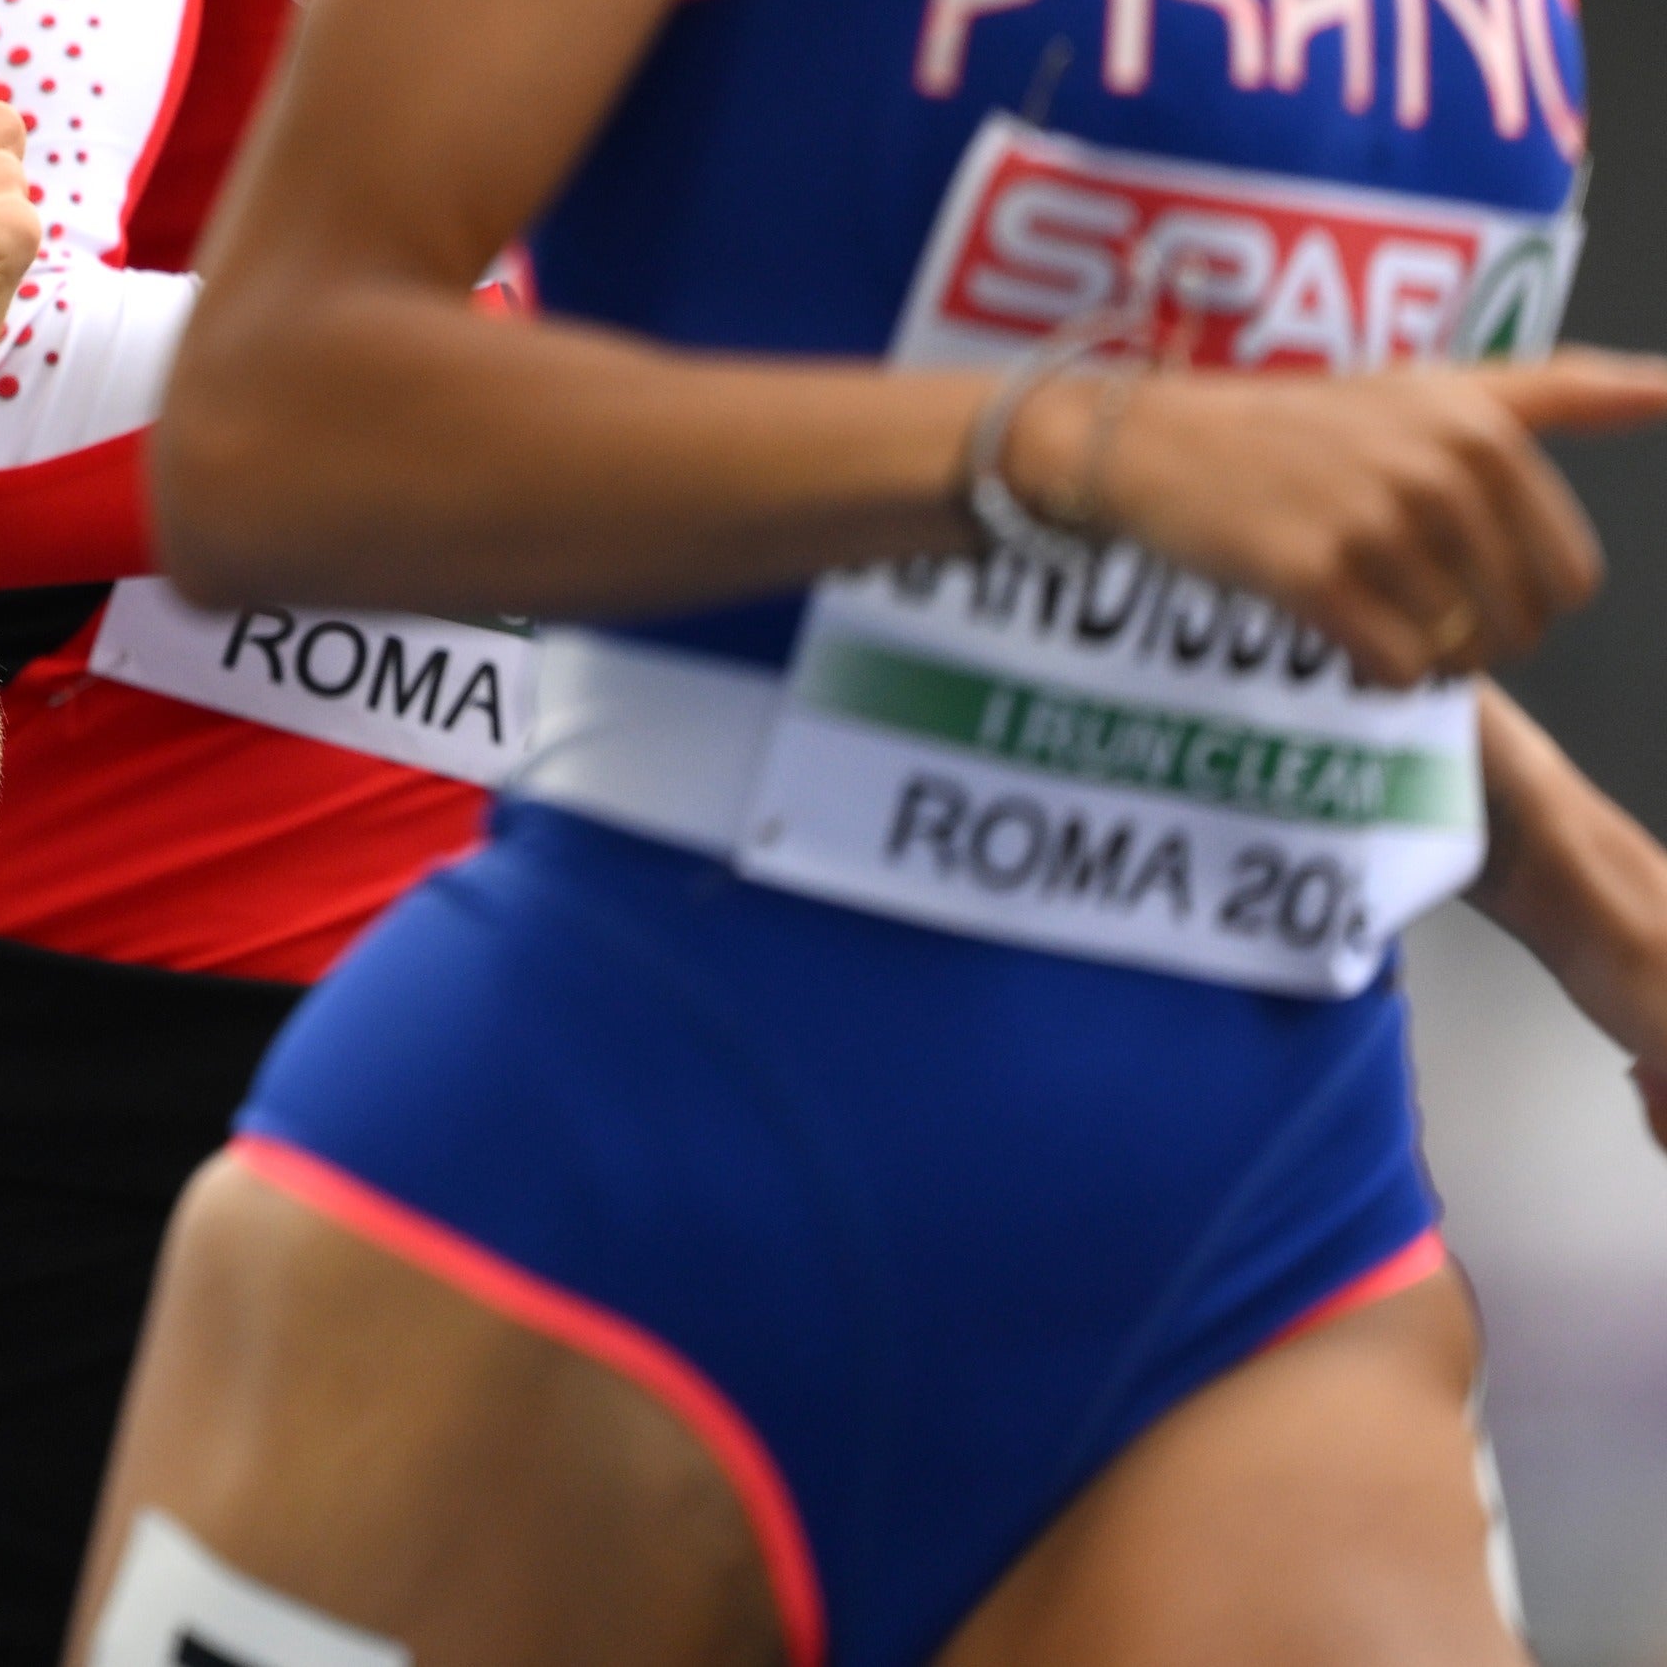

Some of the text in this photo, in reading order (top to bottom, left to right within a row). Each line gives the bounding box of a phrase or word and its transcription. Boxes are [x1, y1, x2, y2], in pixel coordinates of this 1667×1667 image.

[969, 176, 1467, 374] SPAR
[221, 606, 505, 746] ROMA
[883, 772, 1197, 918] ROMA
